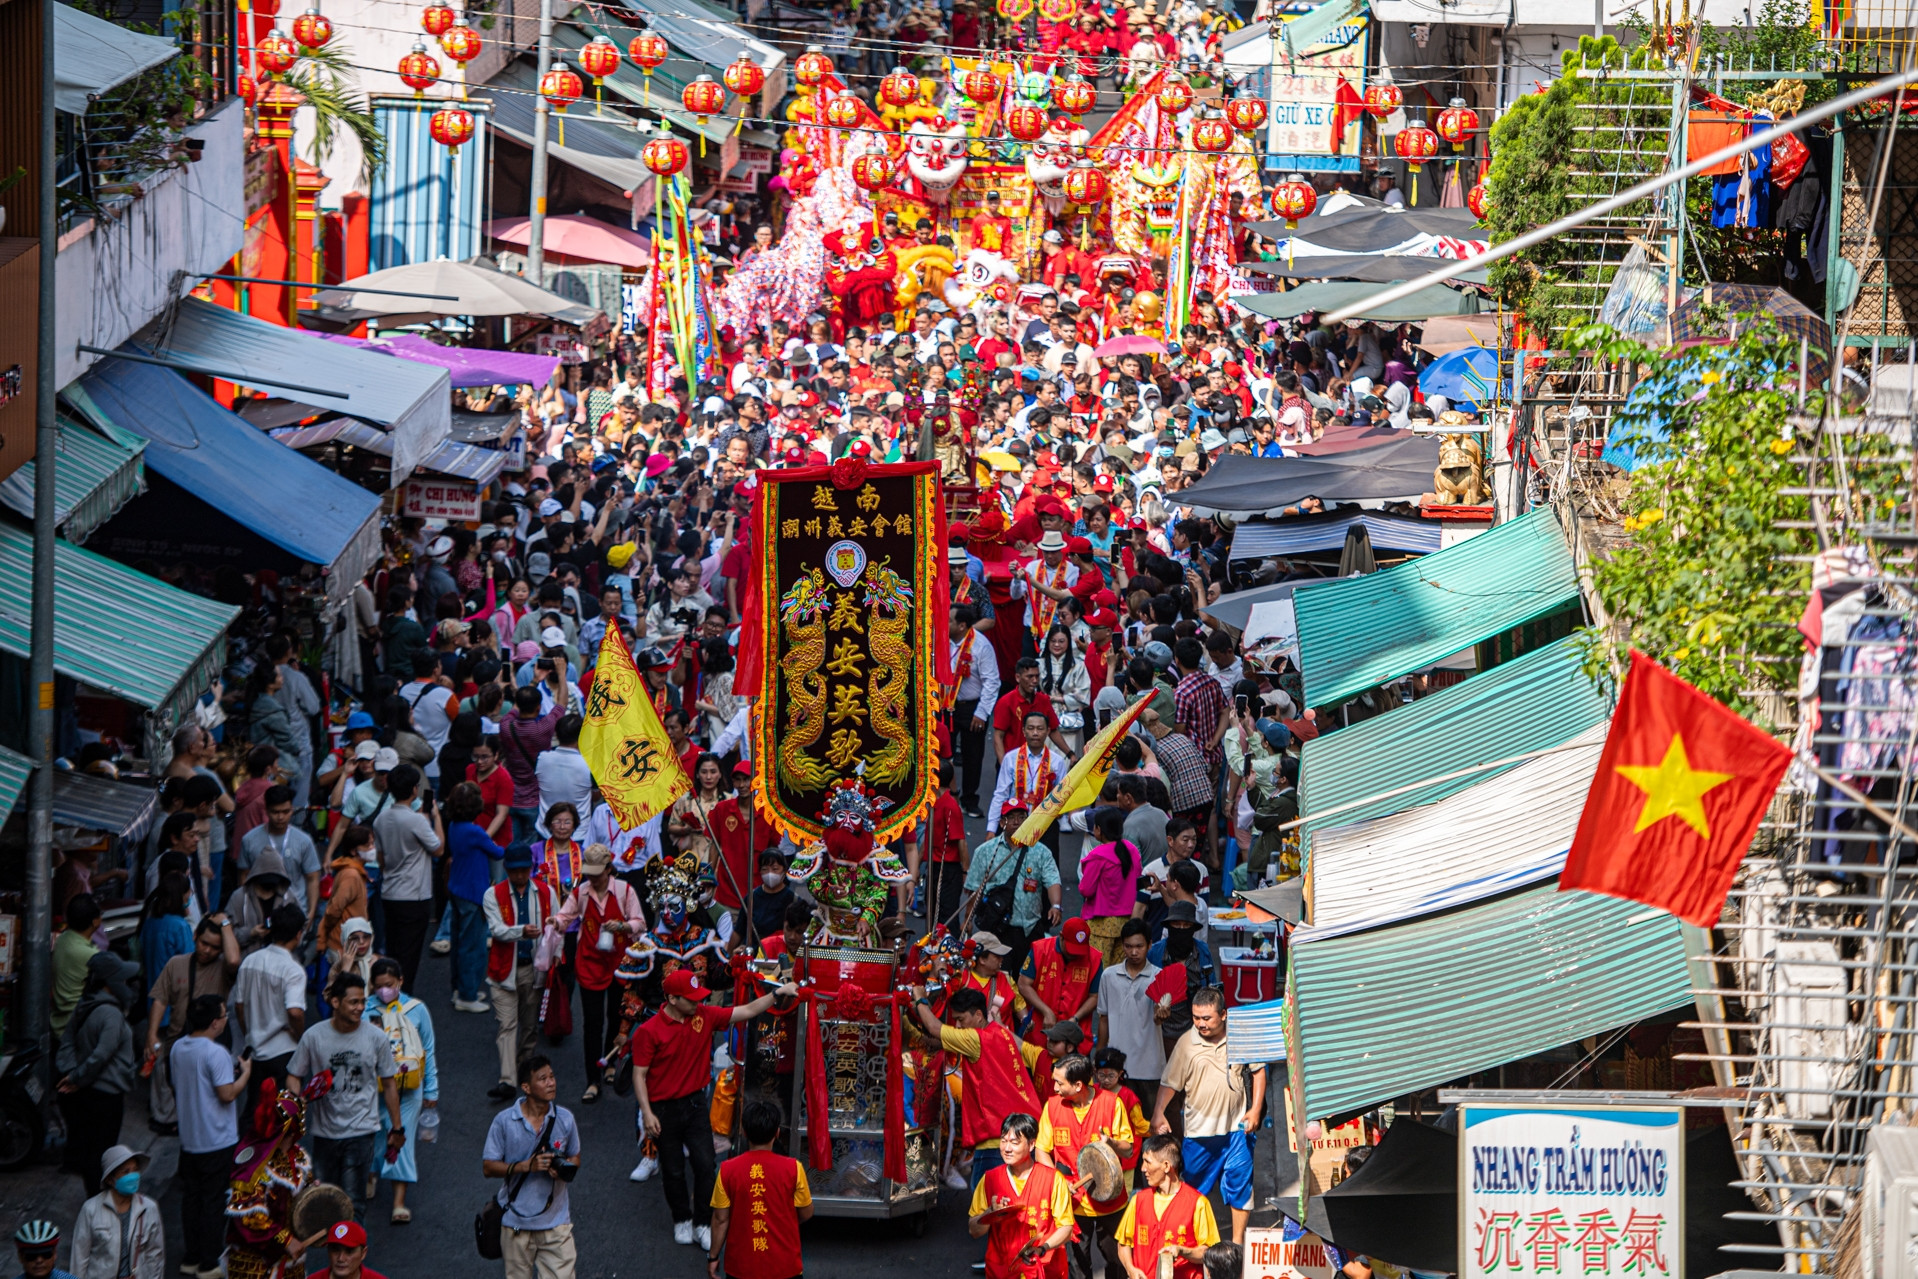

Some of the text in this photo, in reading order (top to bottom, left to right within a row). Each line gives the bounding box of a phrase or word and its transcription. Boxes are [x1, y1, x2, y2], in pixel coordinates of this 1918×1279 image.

[1304, 107, 1323, 125] XE
[425, 487, 444, 504] CHỊ
[782, 513, 913, 539] 潮州義安會館
[825, 591, 868, 770] 義安英歌
[1473, 1146, 1540, 1193] NHANG
[1600, 1140, 1668, 1196] HƯƠNG
[749, 1163, 769, 1252] 義安英歌隊
[1251, 1238, 1326, 1270] TIỆM NHANG
[1474, 1207, 1669, 1277] 沉香香氣
